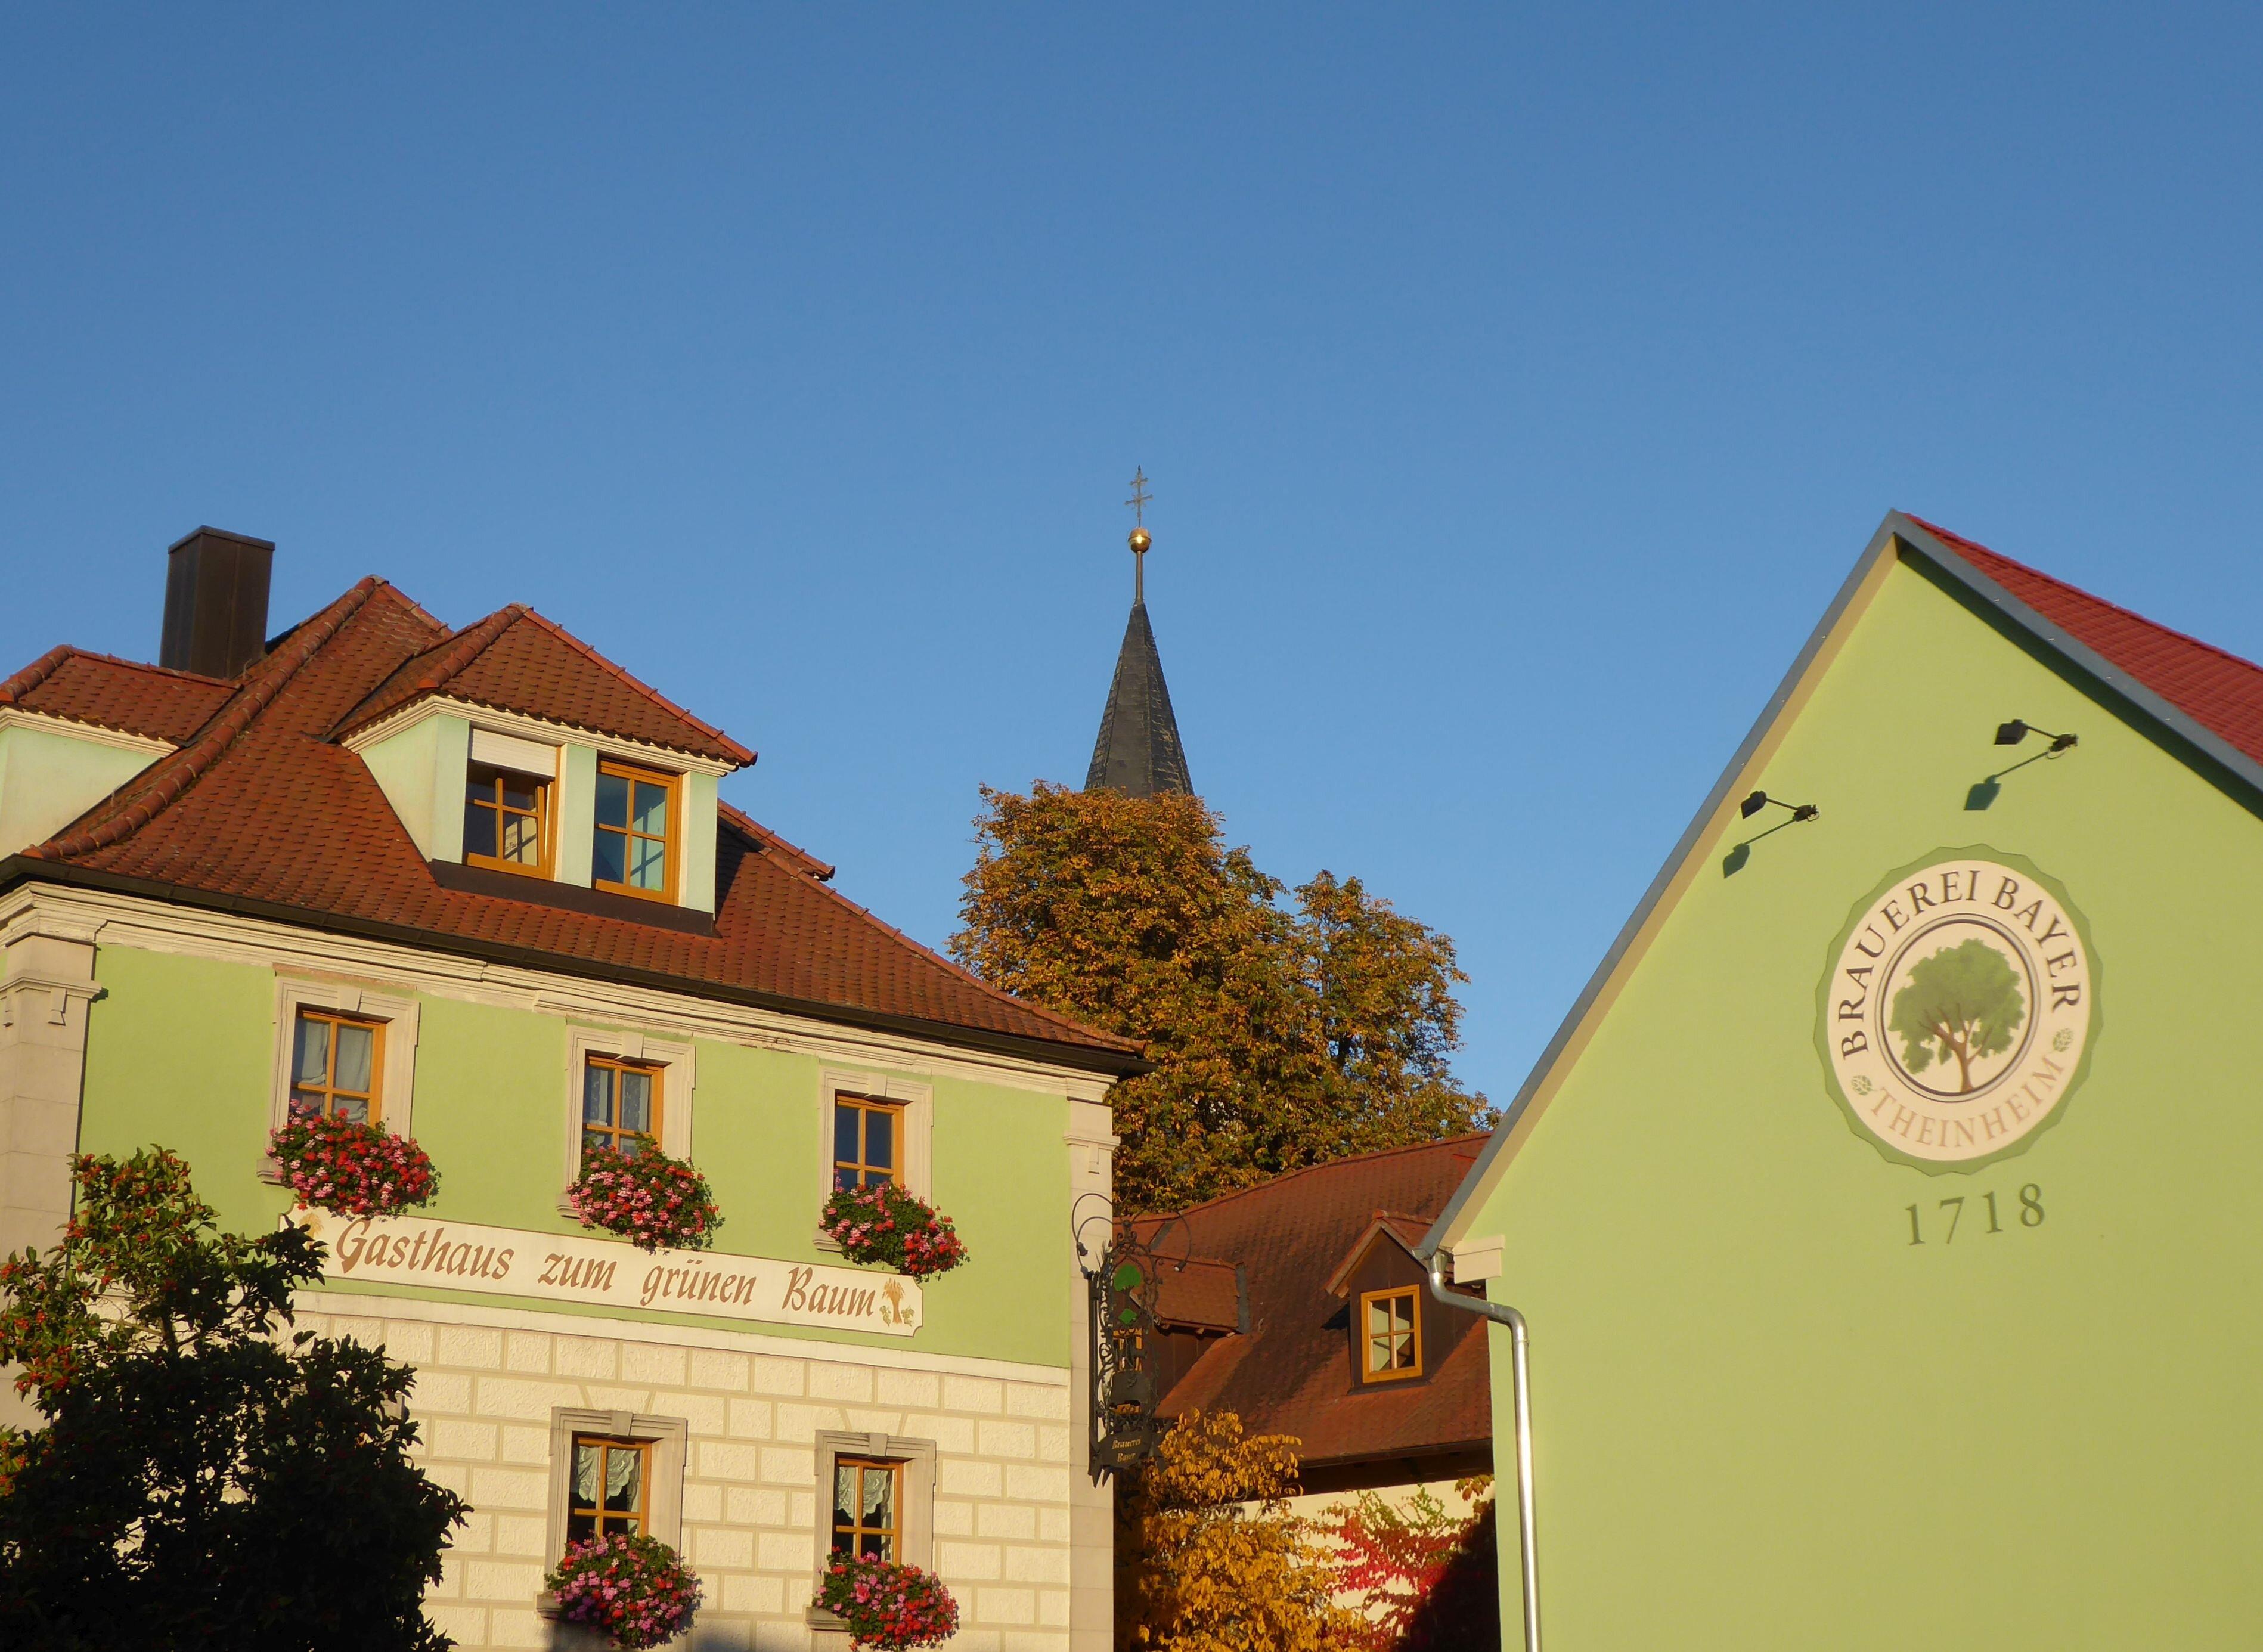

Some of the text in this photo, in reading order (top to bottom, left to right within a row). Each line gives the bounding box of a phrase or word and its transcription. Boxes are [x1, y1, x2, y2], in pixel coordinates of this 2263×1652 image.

[1839, 870, 2081, 1060] BRAUEREI BAYER
[1870, 1057, 2064, 1148] THEINHEIM
[1905, 1183, 2045, 1246] 1718
[336, 1217, 876, 1316] Gasthaus zum grünen Baum
